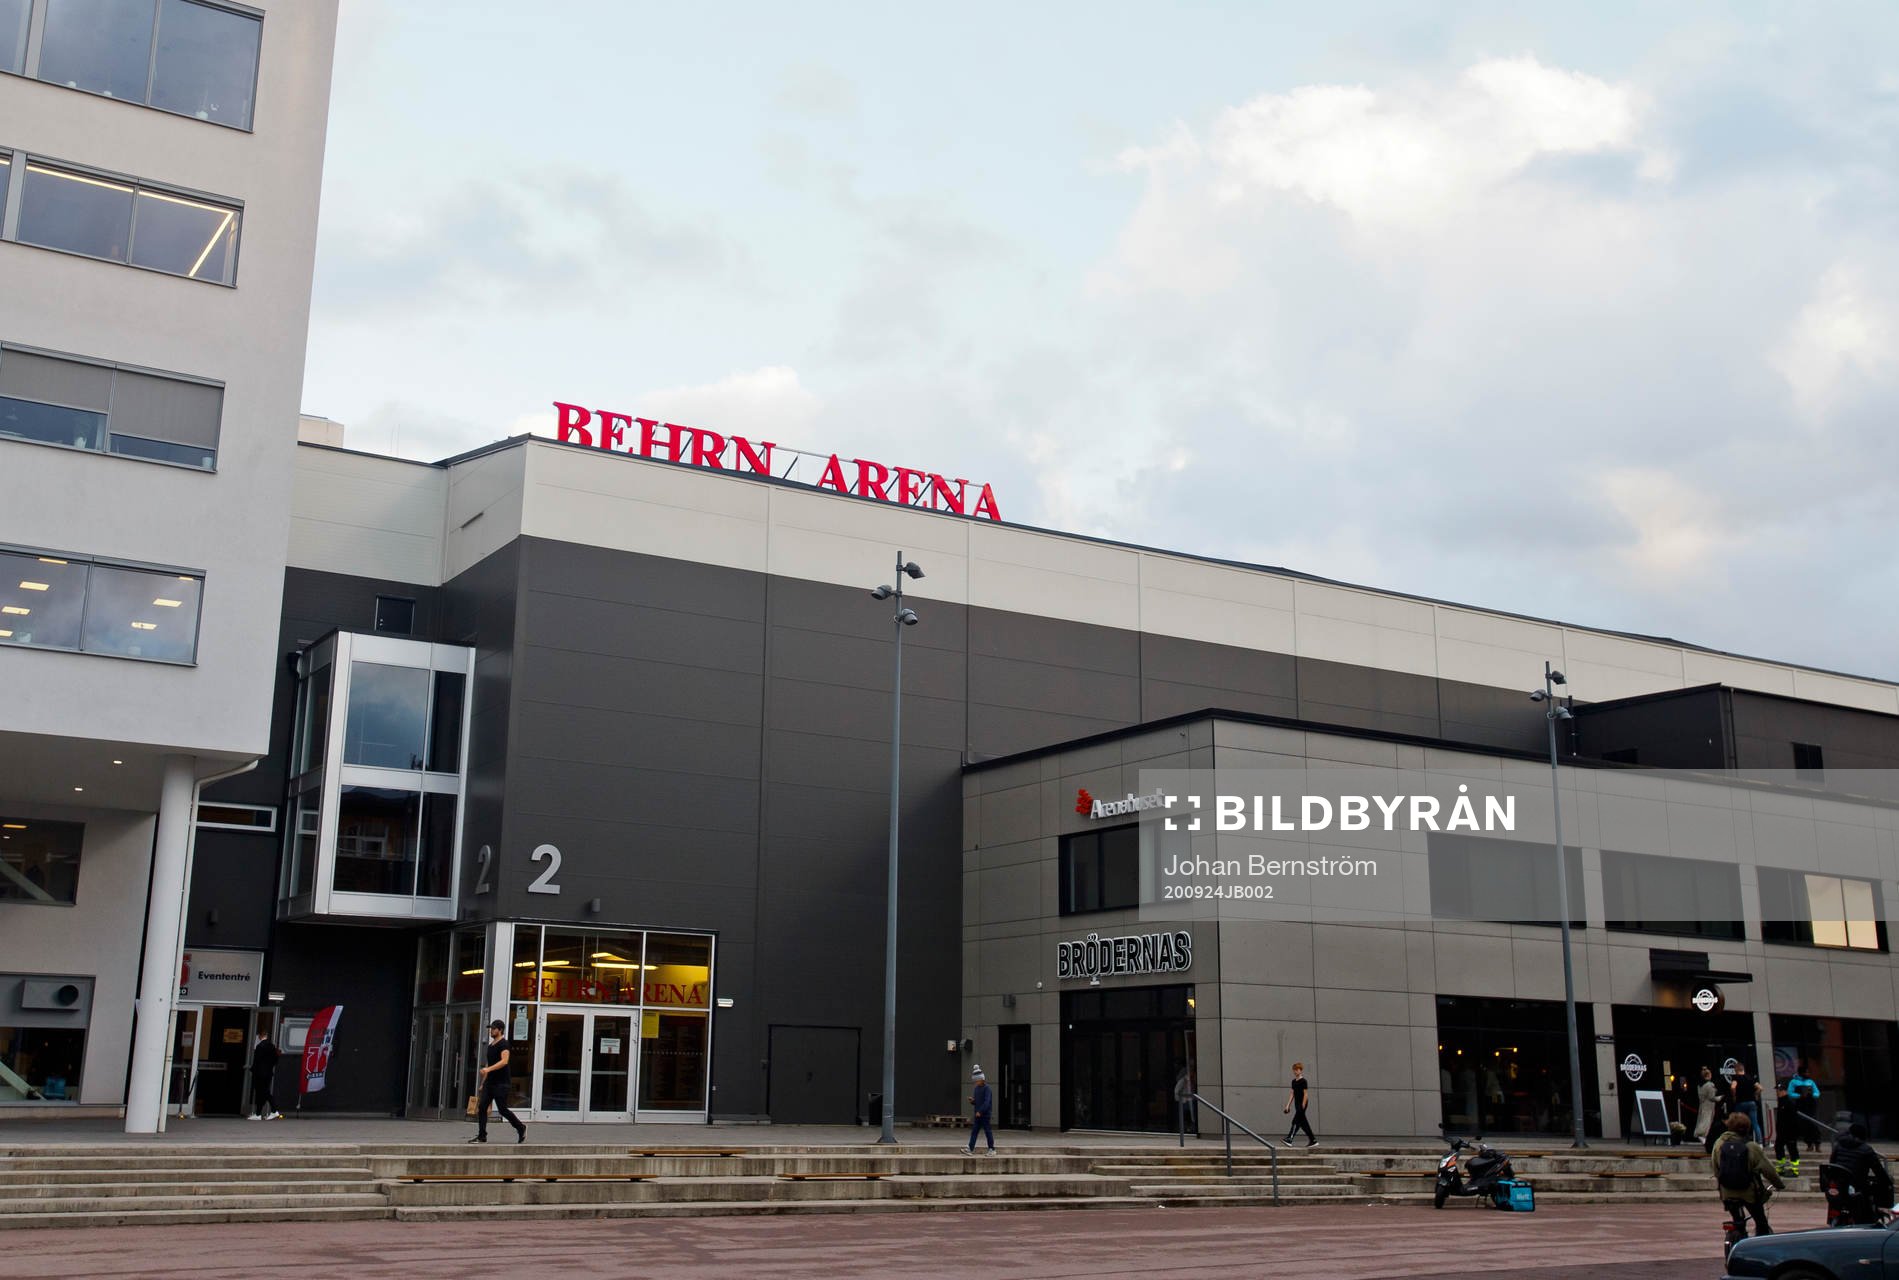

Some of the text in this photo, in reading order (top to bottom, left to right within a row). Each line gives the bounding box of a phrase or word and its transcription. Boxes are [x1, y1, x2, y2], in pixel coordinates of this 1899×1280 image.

[553, 401, 1001, 521] BEHRN ARENA
[1090, 787, 1166, 819] Arenahuset
[475, 845, 491, 895] 2
[528, 844, 562, 894] 2
[198, 971, 251, 982] Evententré
[1057, 931, 1193, 978] BRÖDERNAS
[522, 977, 704, 1005] BEHRN ARENA
